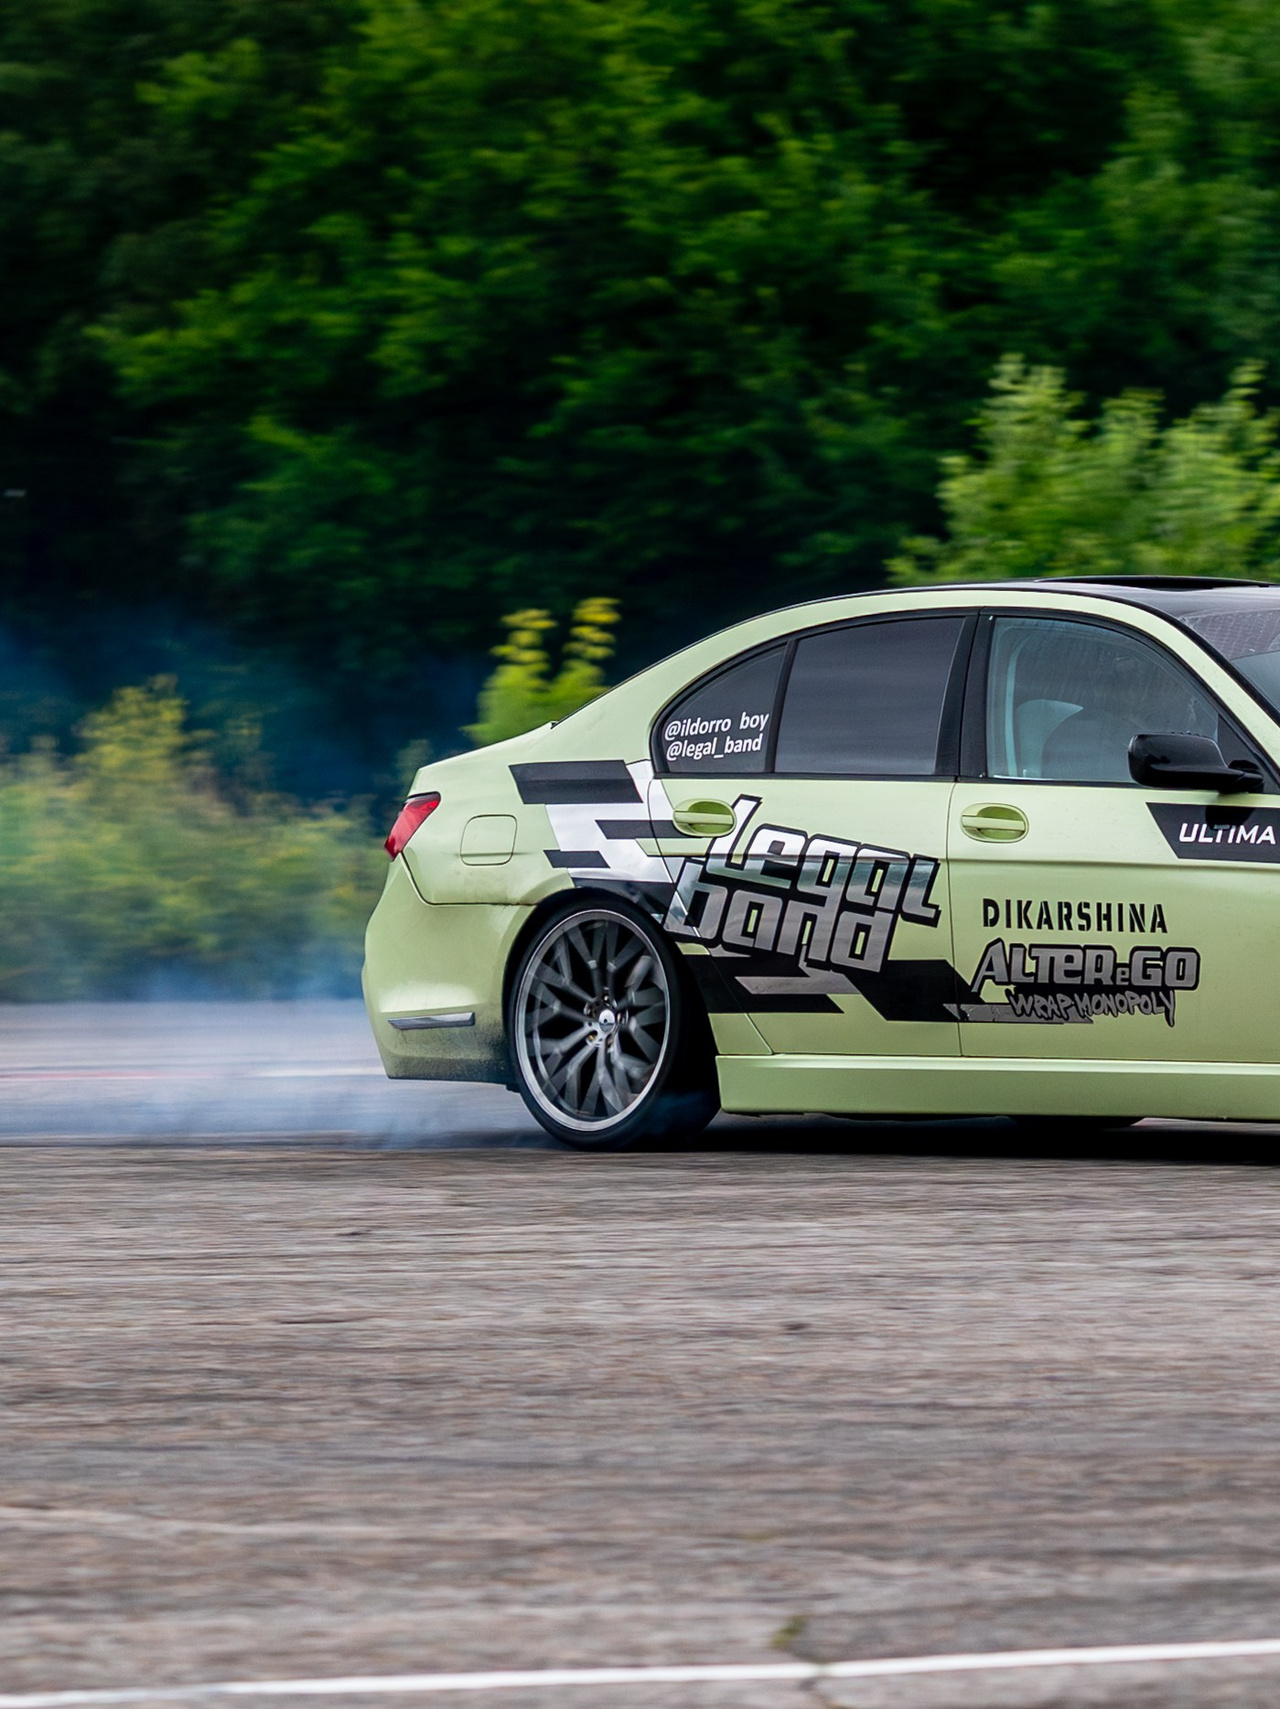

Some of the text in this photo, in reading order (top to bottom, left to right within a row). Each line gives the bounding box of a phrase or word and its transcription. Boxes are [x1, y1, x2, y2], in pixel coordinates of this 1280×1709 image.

[664, 711, 770, 741] @ildorro boy
[666, 732, 764, 761] @legal_band
[1178, 822, 1277, 846] ULTIMA
[982, 897, 1169, 935] DIKARSHINA
